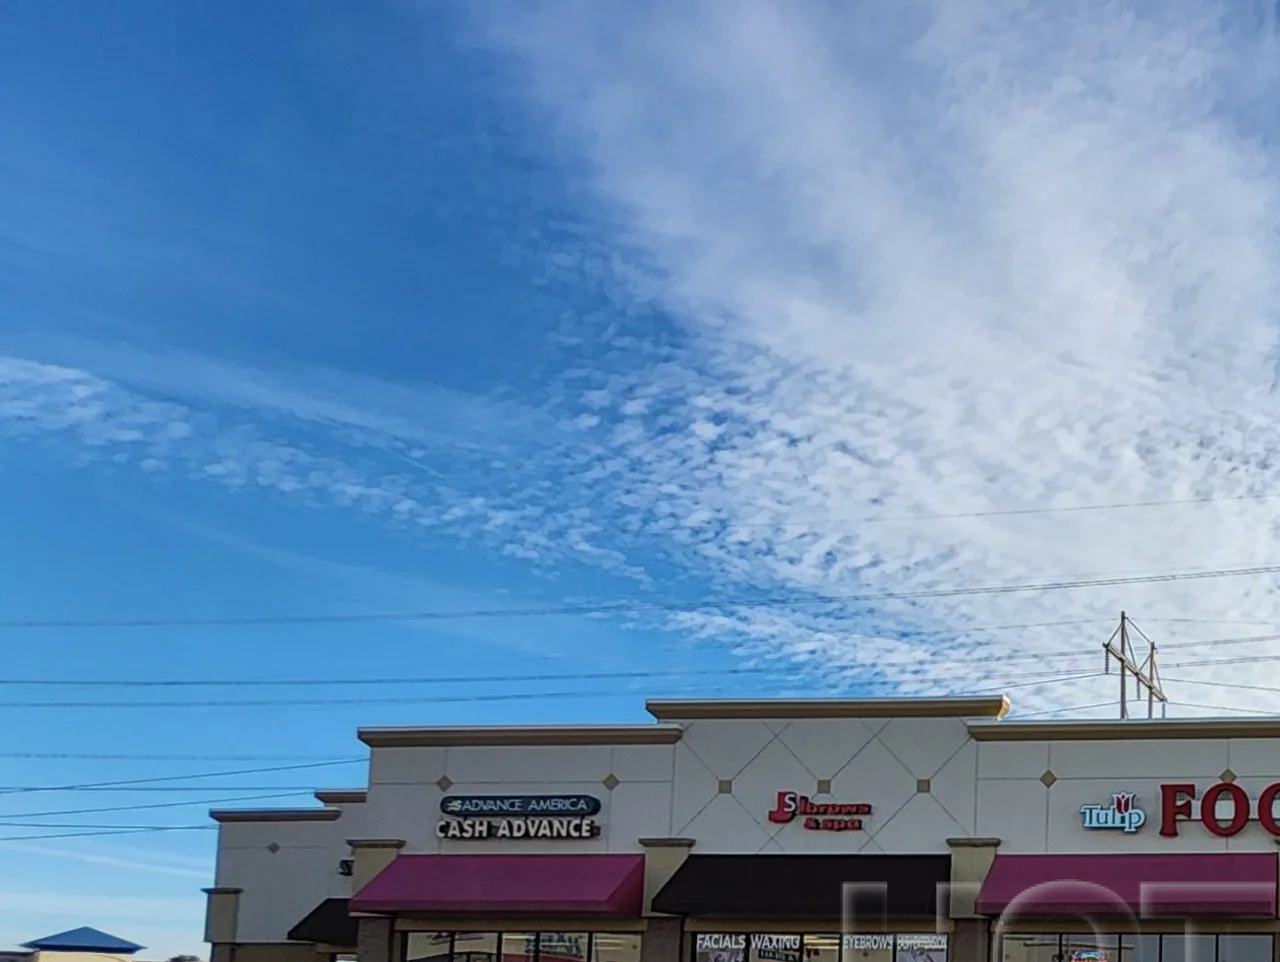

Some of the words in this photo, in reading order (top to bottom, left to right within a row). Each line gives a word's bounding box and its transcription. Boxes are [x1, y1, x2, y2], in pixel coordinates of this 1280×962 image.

[462, 799, 523, 811] ADVANCE
[527, 798, 588, 811] AMERICA
[1080, 800, 1146, 833] Tulip
[436, 819, 488, 838] CASH
[497, 819, 592, 838] ADVANCE
[697, 934, 746, 950] FACIALS
[750, 934, 800, 951] WAXING
[843, 934, 893, 951] EYEBROWS
